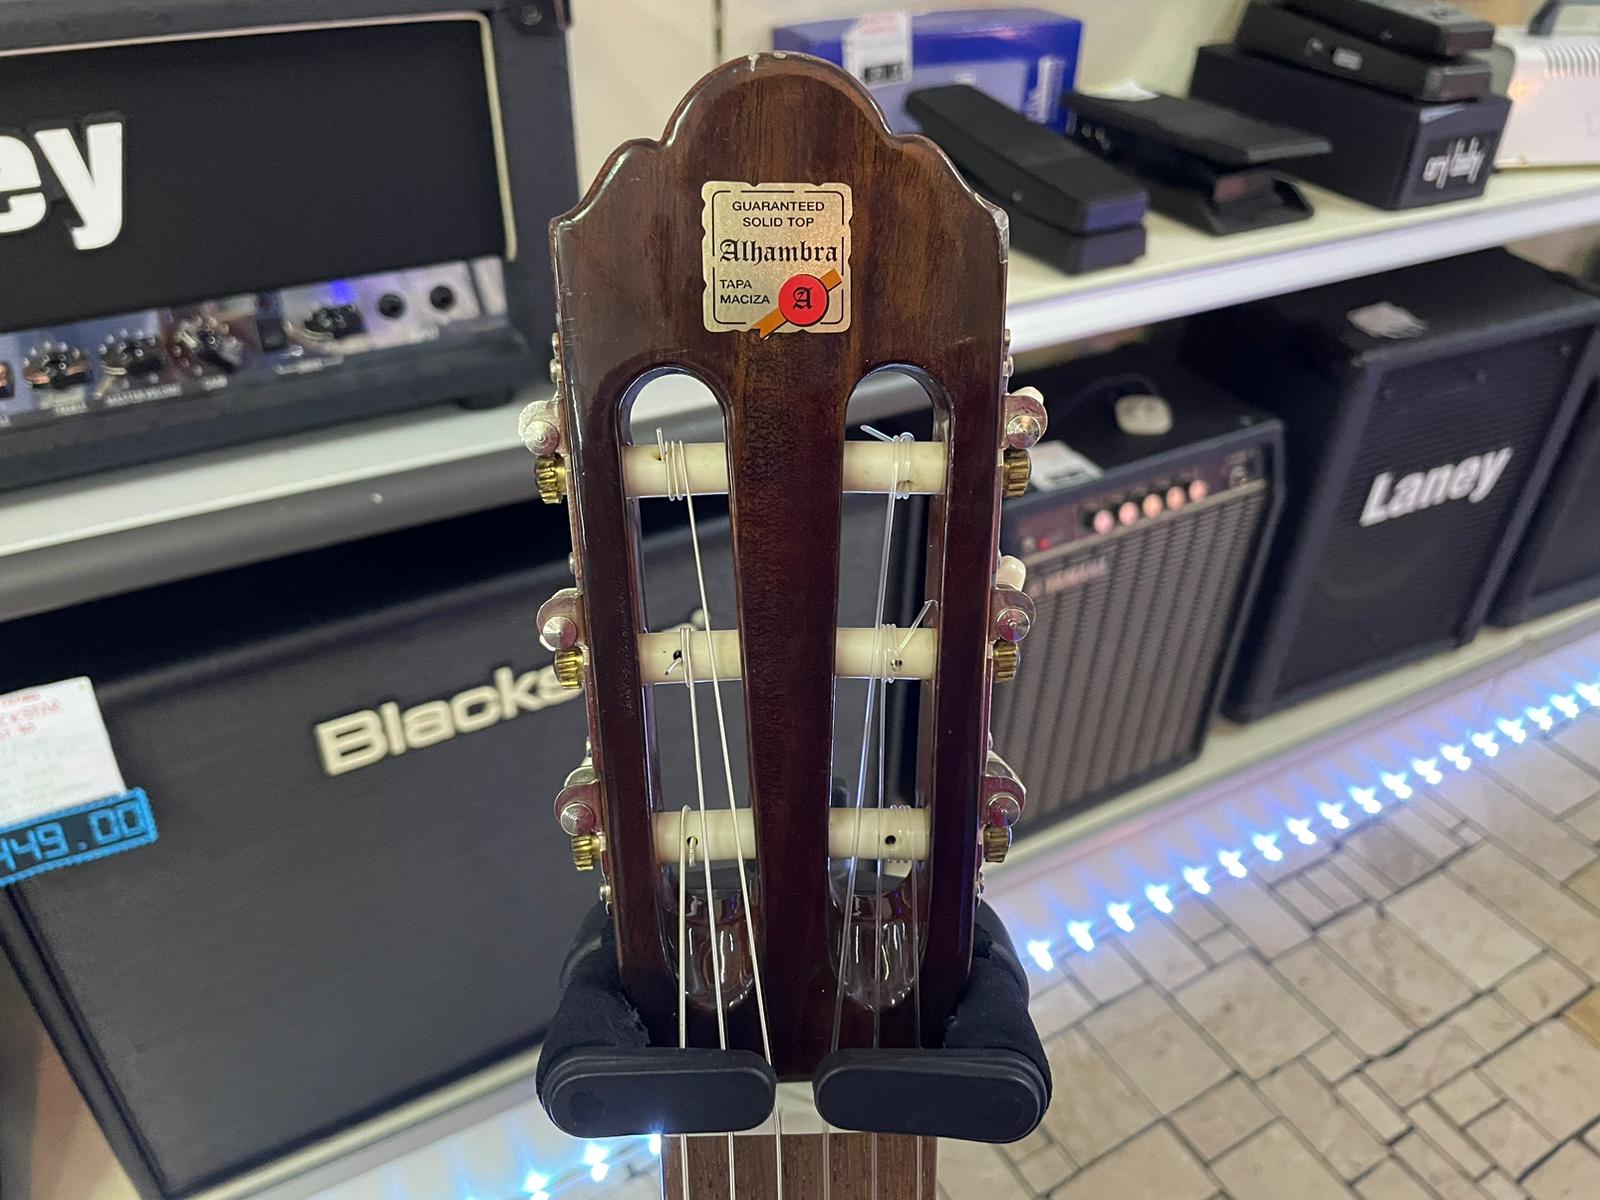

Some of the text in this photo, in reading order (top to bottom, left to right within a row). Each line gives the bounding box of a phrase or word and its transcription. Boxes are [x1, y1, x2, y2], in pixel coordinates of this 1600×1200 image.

[0, 122, 123, 250] ey
[732, 201, 825, 212] GUARANTEED
[742, 217, 815, 228] SOLID TOP
[719, 238, 838, 267] Alhambra
[719, 279, 753, 289] TAPA
[719, 294, 771, 304] MACIZA
[792, 286, 814, 310] A
[1359, 447, 1514, 527] Laney
